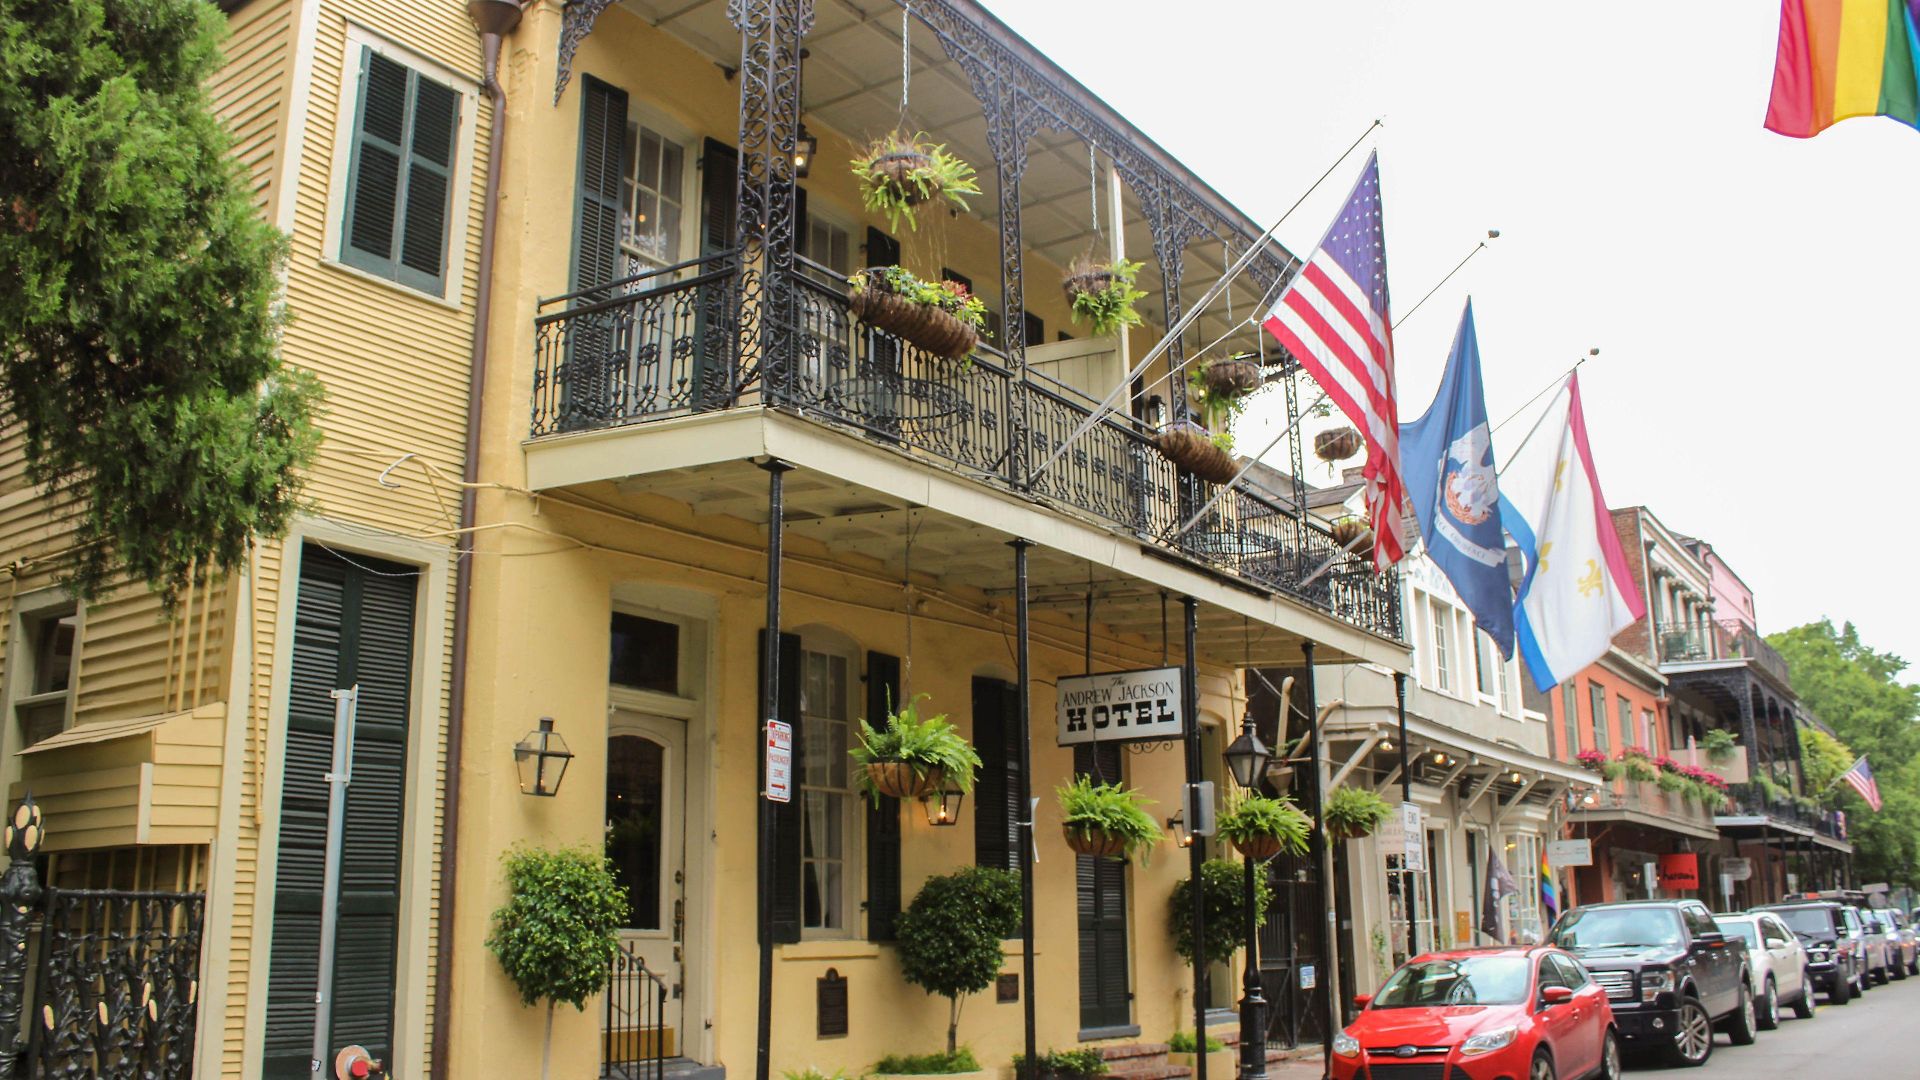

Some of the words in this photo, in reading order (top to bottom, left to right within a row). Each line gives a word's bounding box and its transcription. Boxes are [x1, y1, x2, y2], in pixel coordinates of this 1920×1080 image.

[1063, 689, 1112, 707] ANDREW
[1118, 681, 1175, 701] JACKSON
[1111, 676, 1127, 687] The
[1066, 699, 1175, 732] HOTEL
